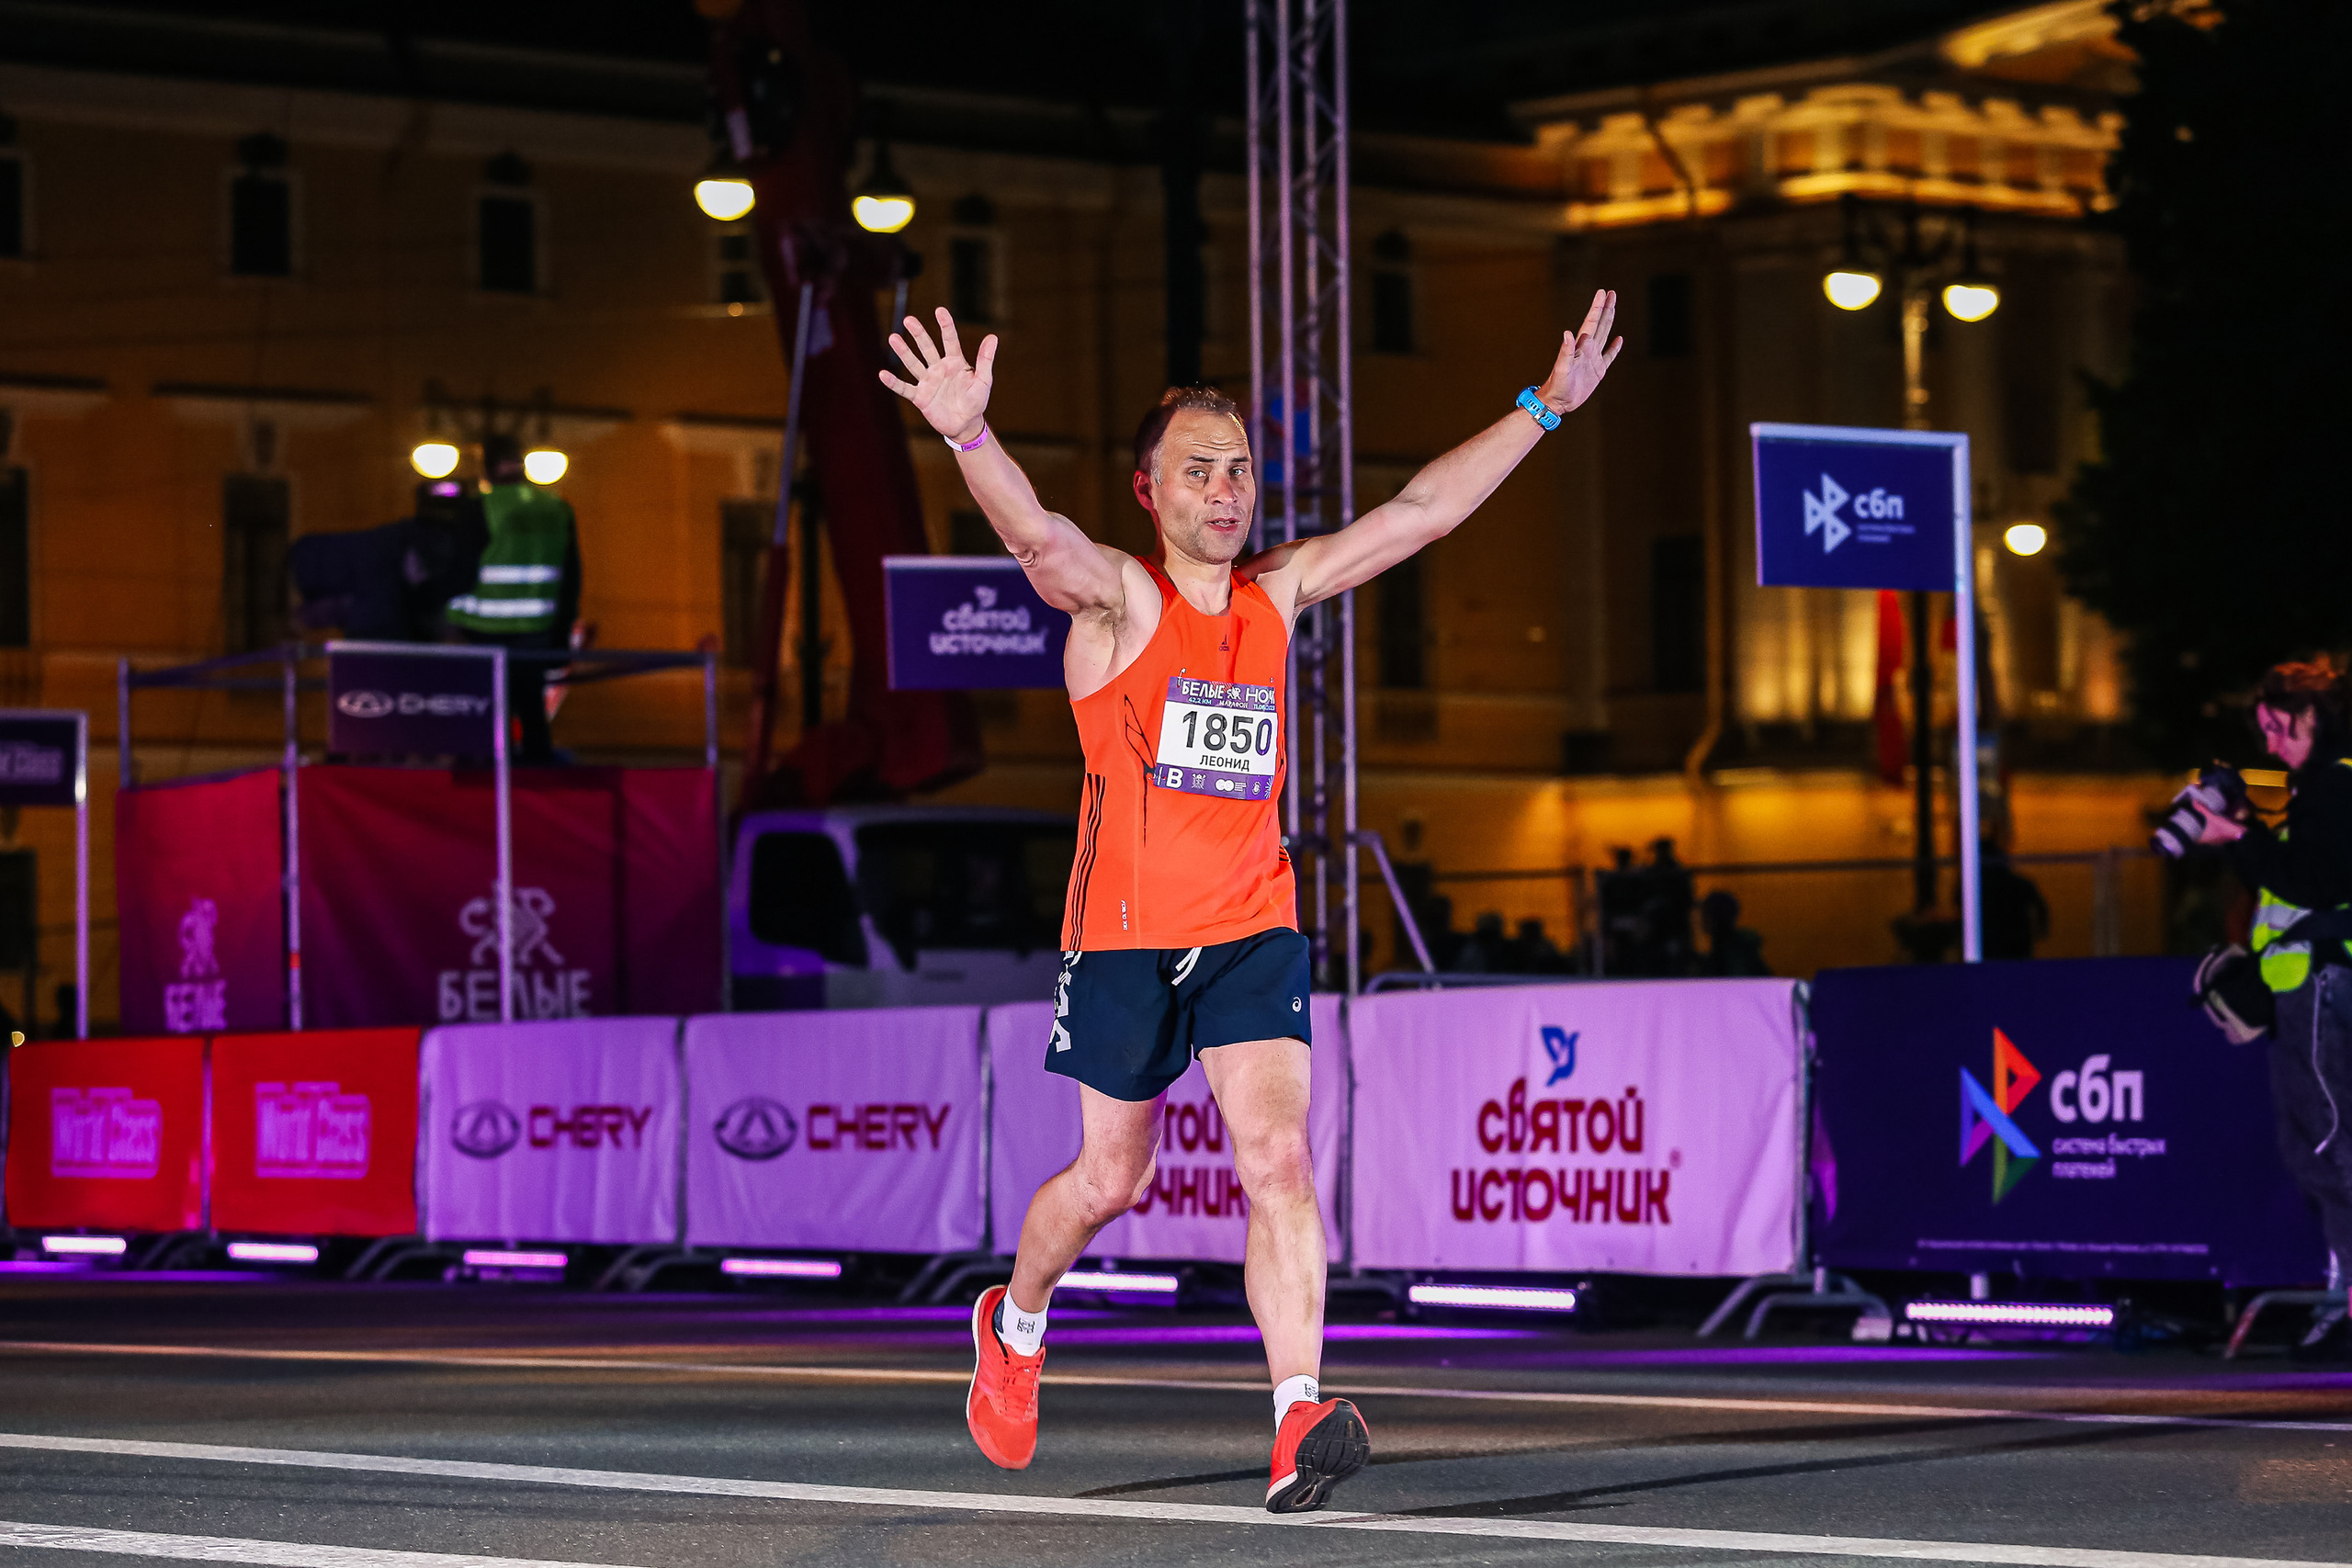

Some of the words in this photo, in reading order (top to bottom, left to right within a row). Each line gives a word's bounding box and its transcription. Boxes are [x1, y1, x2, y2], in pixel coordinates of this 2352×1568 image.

[1182, 680, 1225, 699] БЕЛЫЕ
[1182, 710, 1272, 756] 1850
[1199, 755, 1250, 772] ЛЕОНИД
[438, 969, 592, 1020] БЕЛЫЕ
[2050, 1054, 2143, 1122] сбп
[528, 1105, 651, 1150] CHERY
[807, 1104, 950, 1150] CHERY
